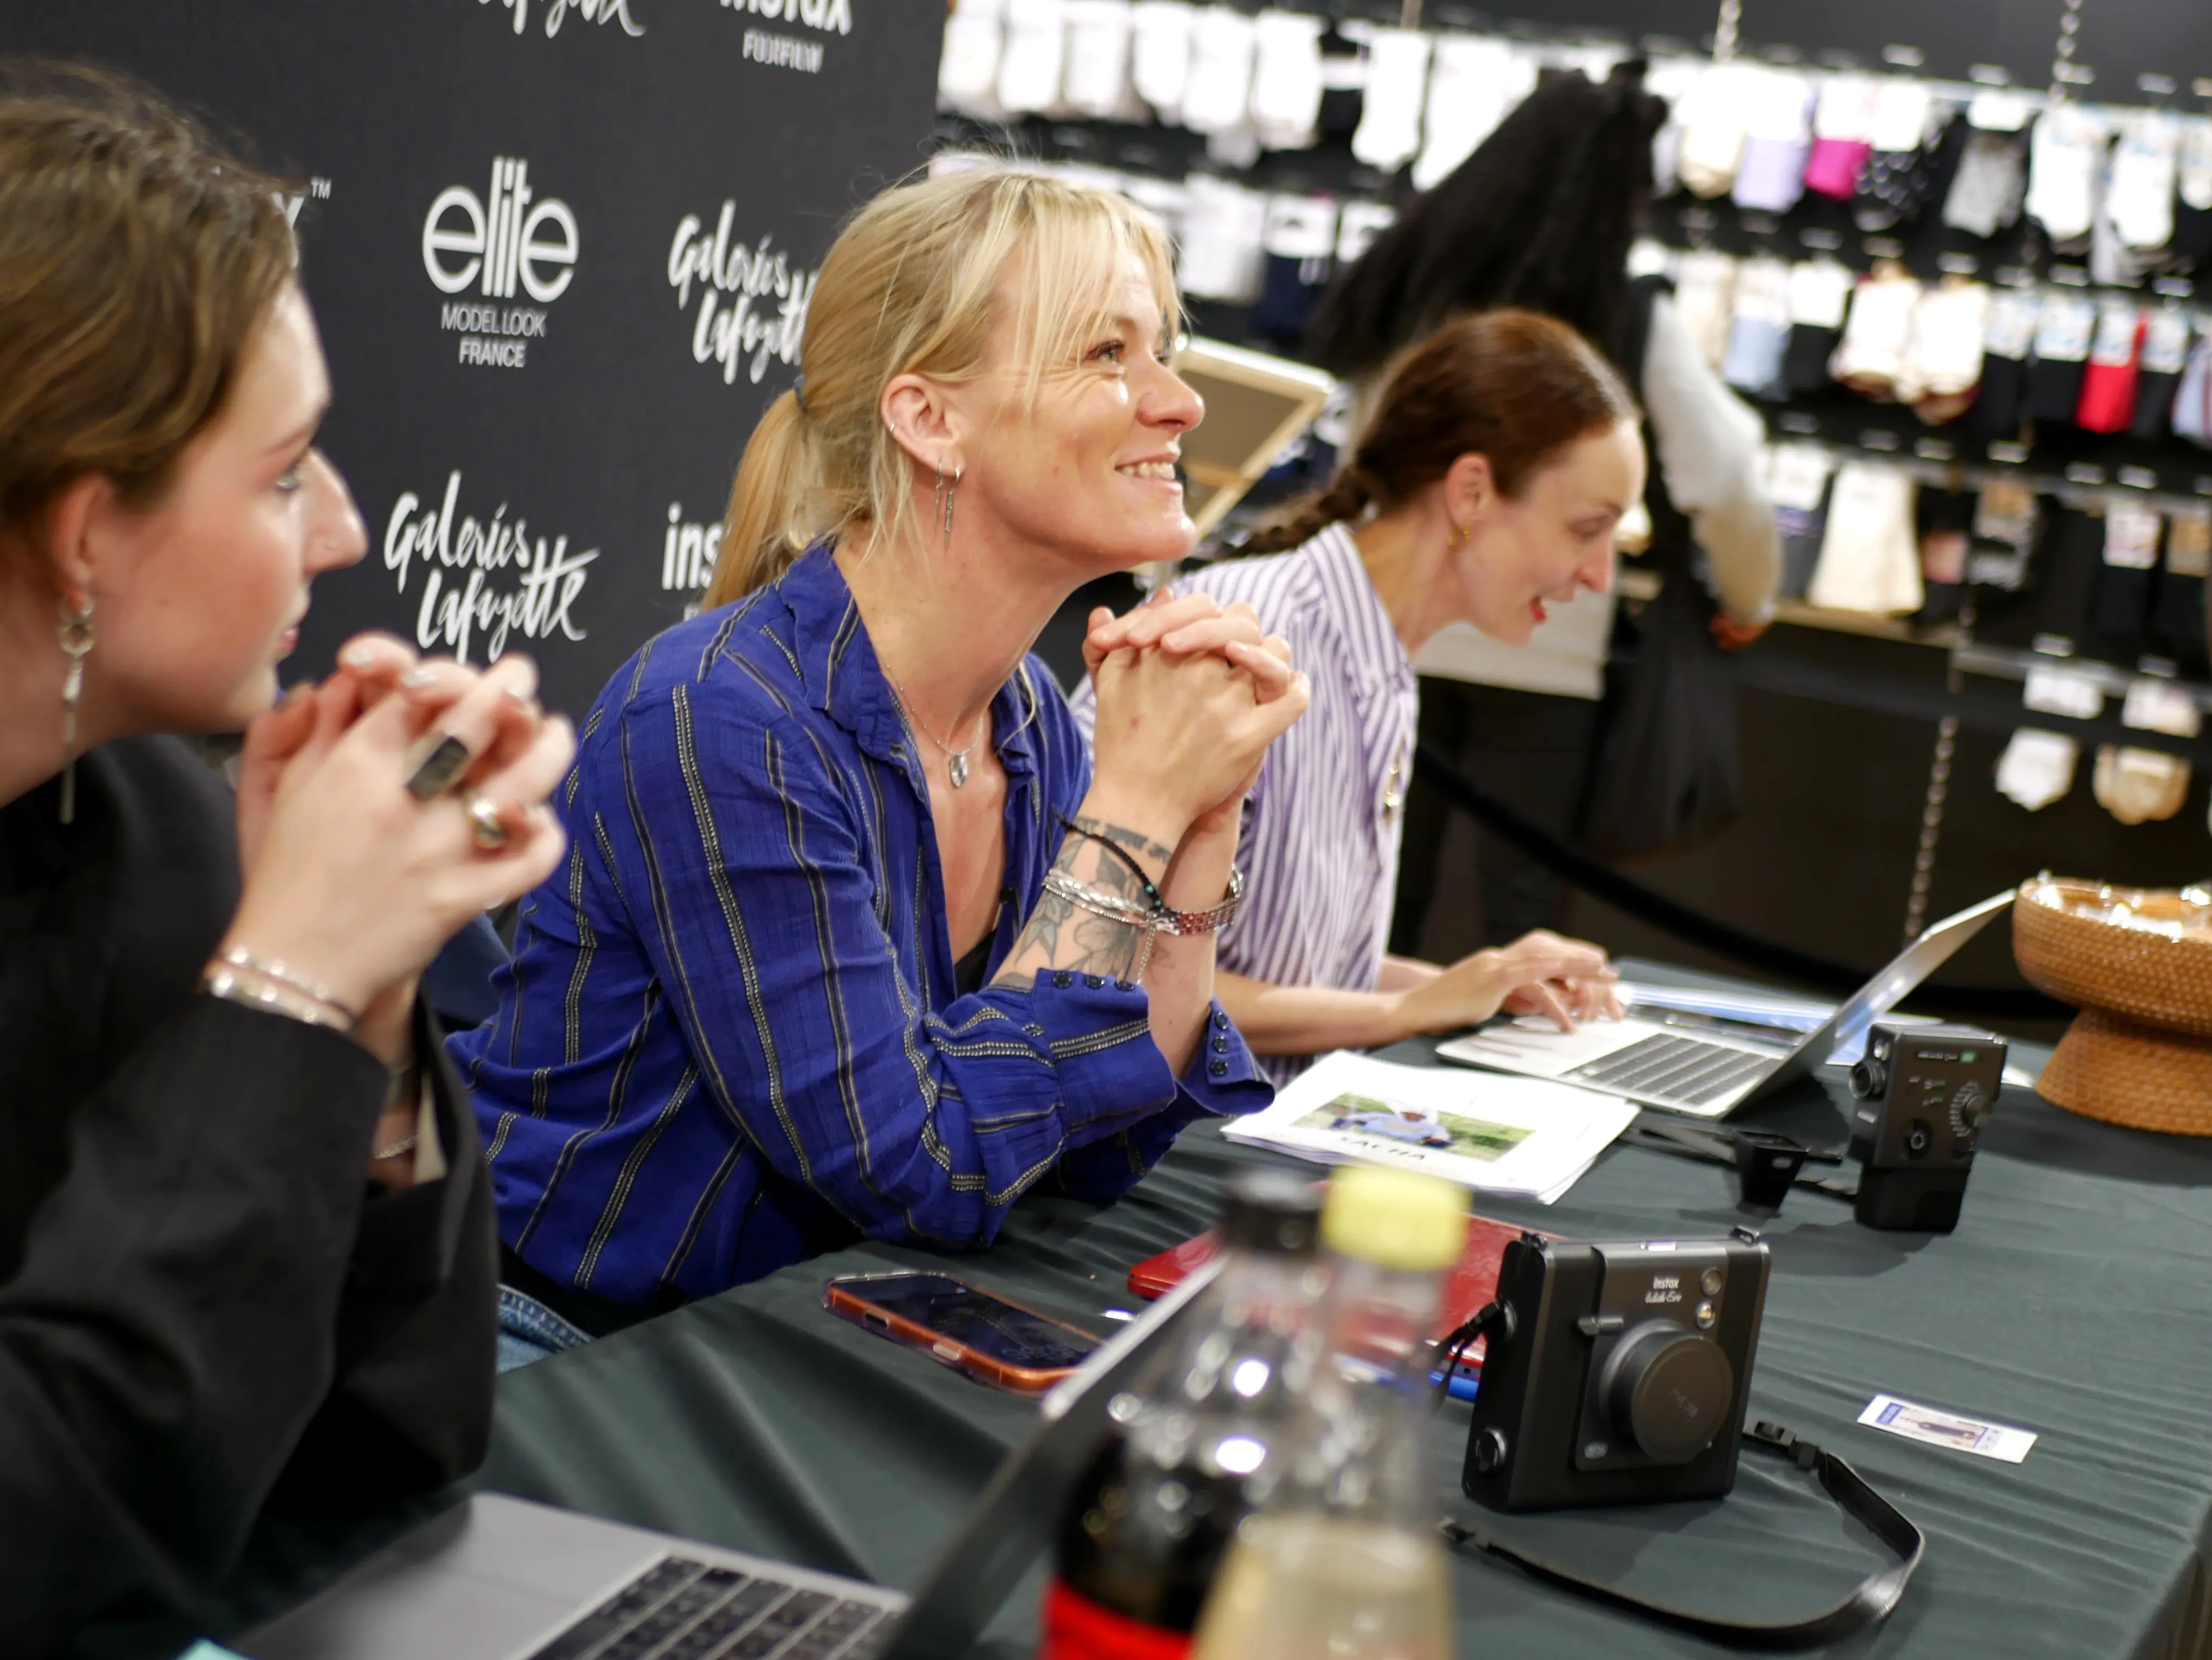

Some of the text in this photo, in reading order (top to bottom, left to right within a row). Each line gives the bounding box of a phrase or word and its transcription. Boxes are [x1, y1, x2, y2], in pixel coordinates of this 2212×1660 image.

[743, 28, 824, 74] FUJIFILM
[422, 155, 579, 303] elite
[441, 302, 547, 338] MODEL LOOK
[459, 336, 527, 368] FRANCE
[693, 269, 820, 385] Lafayett
[384, 469, 531, 594] Galeries
[662, 501, 724, 590] ins
[417, 535, 600, 664] Lafayette
